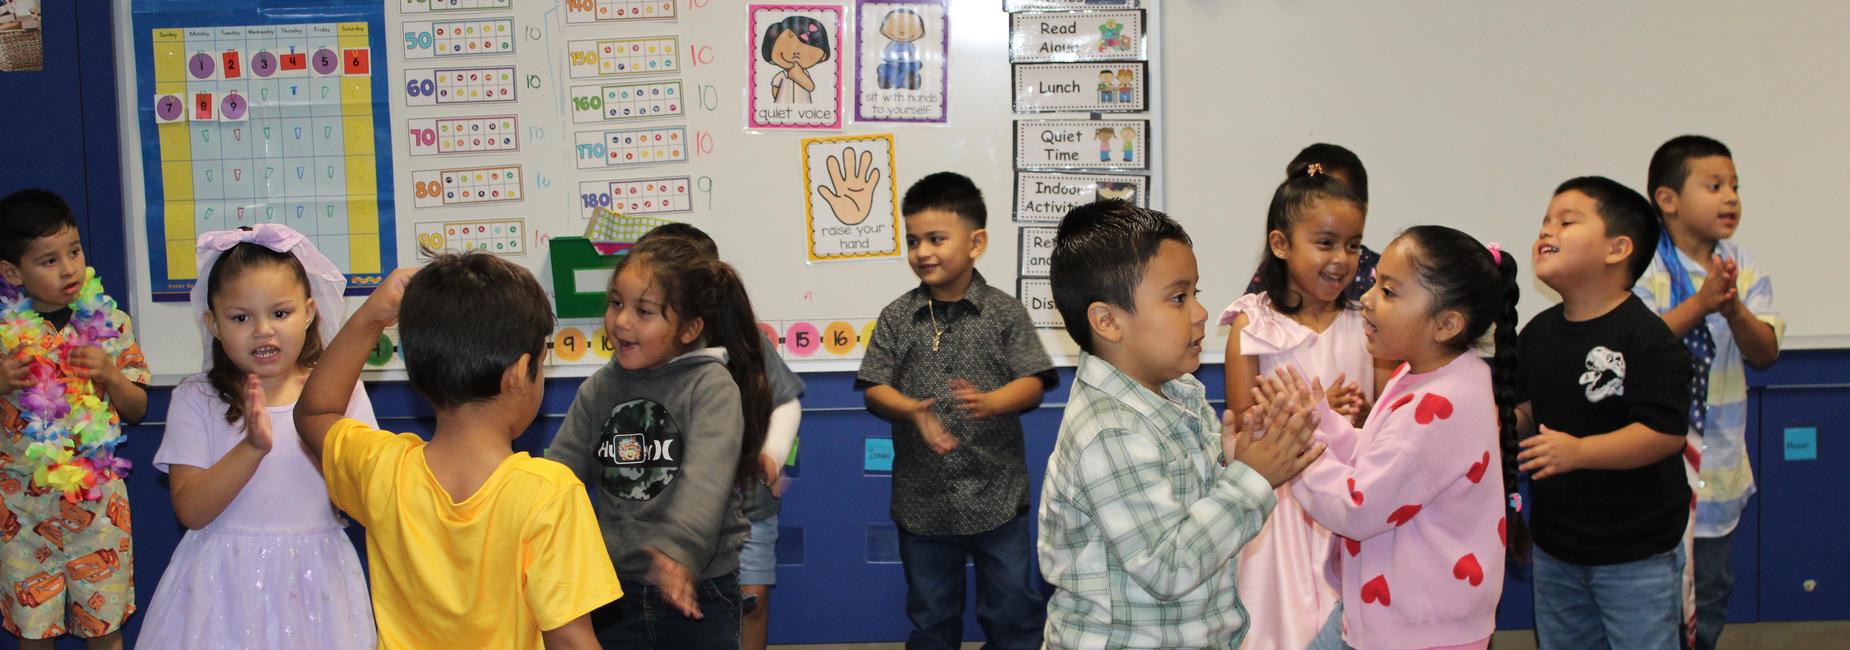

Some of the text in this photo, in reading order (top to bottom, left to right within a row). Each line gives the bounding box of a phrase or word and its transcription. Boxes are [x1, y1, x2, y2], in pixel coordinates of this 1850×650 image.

[567, 0, 593, 13] 140
[189, 31, 210, 39] Monday
[281, 27, 303, 35] Thursday
[314, 26, 331, 34] Friday
[341, 25, 365, 33] Saturday
[525, 25, 542, 41] 10
[1040, 21, 1077, 35] Read
[405, 31, 432, 50] 50
[200, 56, 360, 71] 1 2 3 4 5 6
[570, 50, 597, 66] 150
[690, 44, 714, 67] 10
[406, 78, 435, 97] 60
[526, 74, 542, 90] 10
[1039, 80, 1081, 94] Lunch
[572, 95, 602, 112] 160
[698, 84, 718, 111] 10
[865, 91, 938, 103] sit with hands
[166, 101, 237, 113] 7 8 9
[758, 106, 832, 121] quiet voice
[872, 104, 932, 116] to yourself
[410, 128, 436, 147] 70
[528, 125, 545, 143] 10
[1040, 129, 1083, 145] Quiet
[696, 130, 714, 156] 10
[577, 143, 607, 160] 170
[1043, 149, 1080, 162] Time
[415, 180, 442, 199] 80
[697, 176, 713, 210] 9
[1034, 181, 1082, 196] Indoor
[581, 192, 611, 209] 180
[1025, 200, 1077, 214] Activit
[821, 224, 886, 237] raise your
[418, 232, 443, 250] 90
[839, 238, 870, 250] hand
[1032, 296, 1056, 311] Dis
[563, 335, 574, 352] 9
[601, 335, 615, 352] 10
[796, 331, 810, 348] 15
[833, 330, 848, 346] 16
